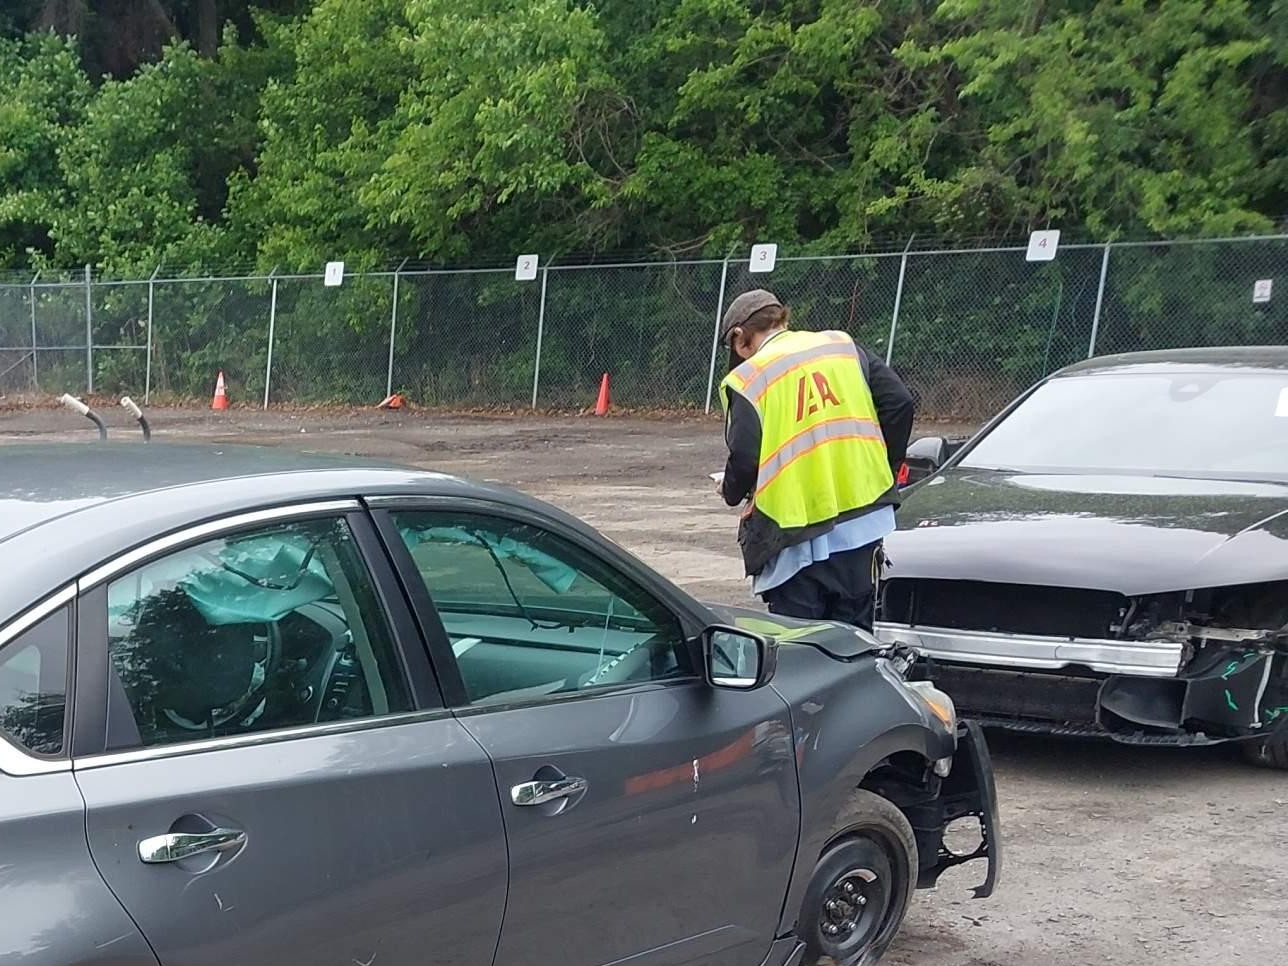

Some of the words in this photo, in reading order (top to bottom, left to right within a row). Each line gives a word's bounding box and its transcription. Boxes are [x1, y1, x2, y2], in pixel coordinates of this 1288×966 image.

[1039, 238, 1048, 248] 4
[759, 250, 768, 261] 3
[523, 260, 531, 270] 2
